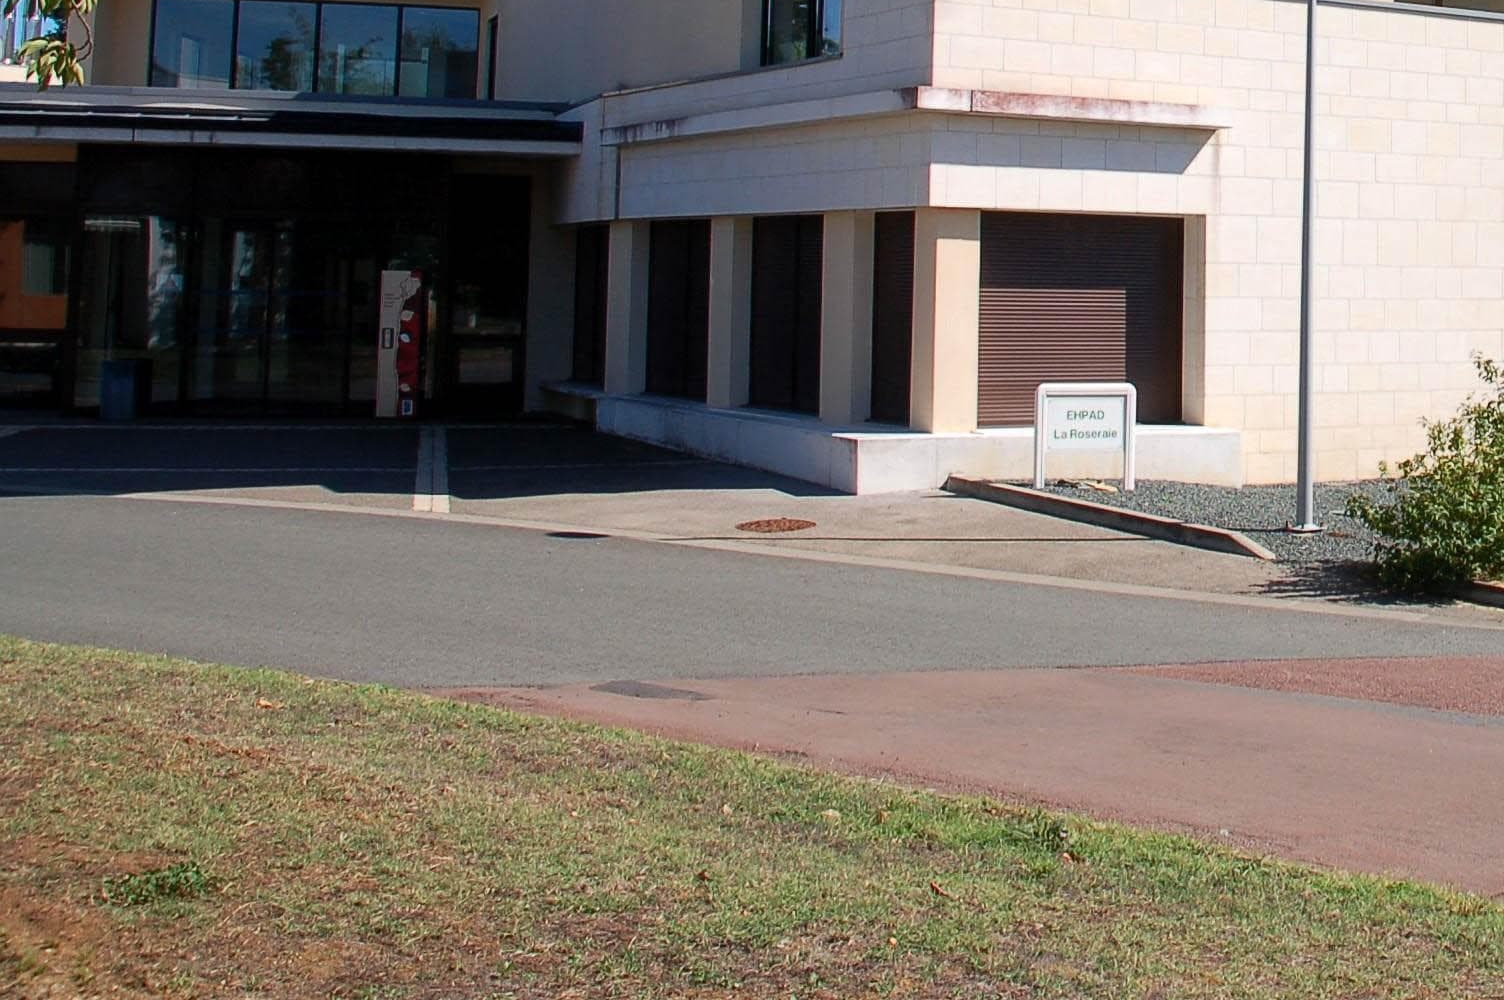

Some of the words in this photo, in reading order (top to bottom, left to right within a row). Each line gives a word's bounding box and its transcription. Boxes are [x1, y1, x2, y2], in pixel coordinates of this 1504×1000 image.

[1066, 410, 1105, 421] EHPAD
[1054, 429, 1067, 440] La
[1070, 429, 1118, 439] Roseraie
